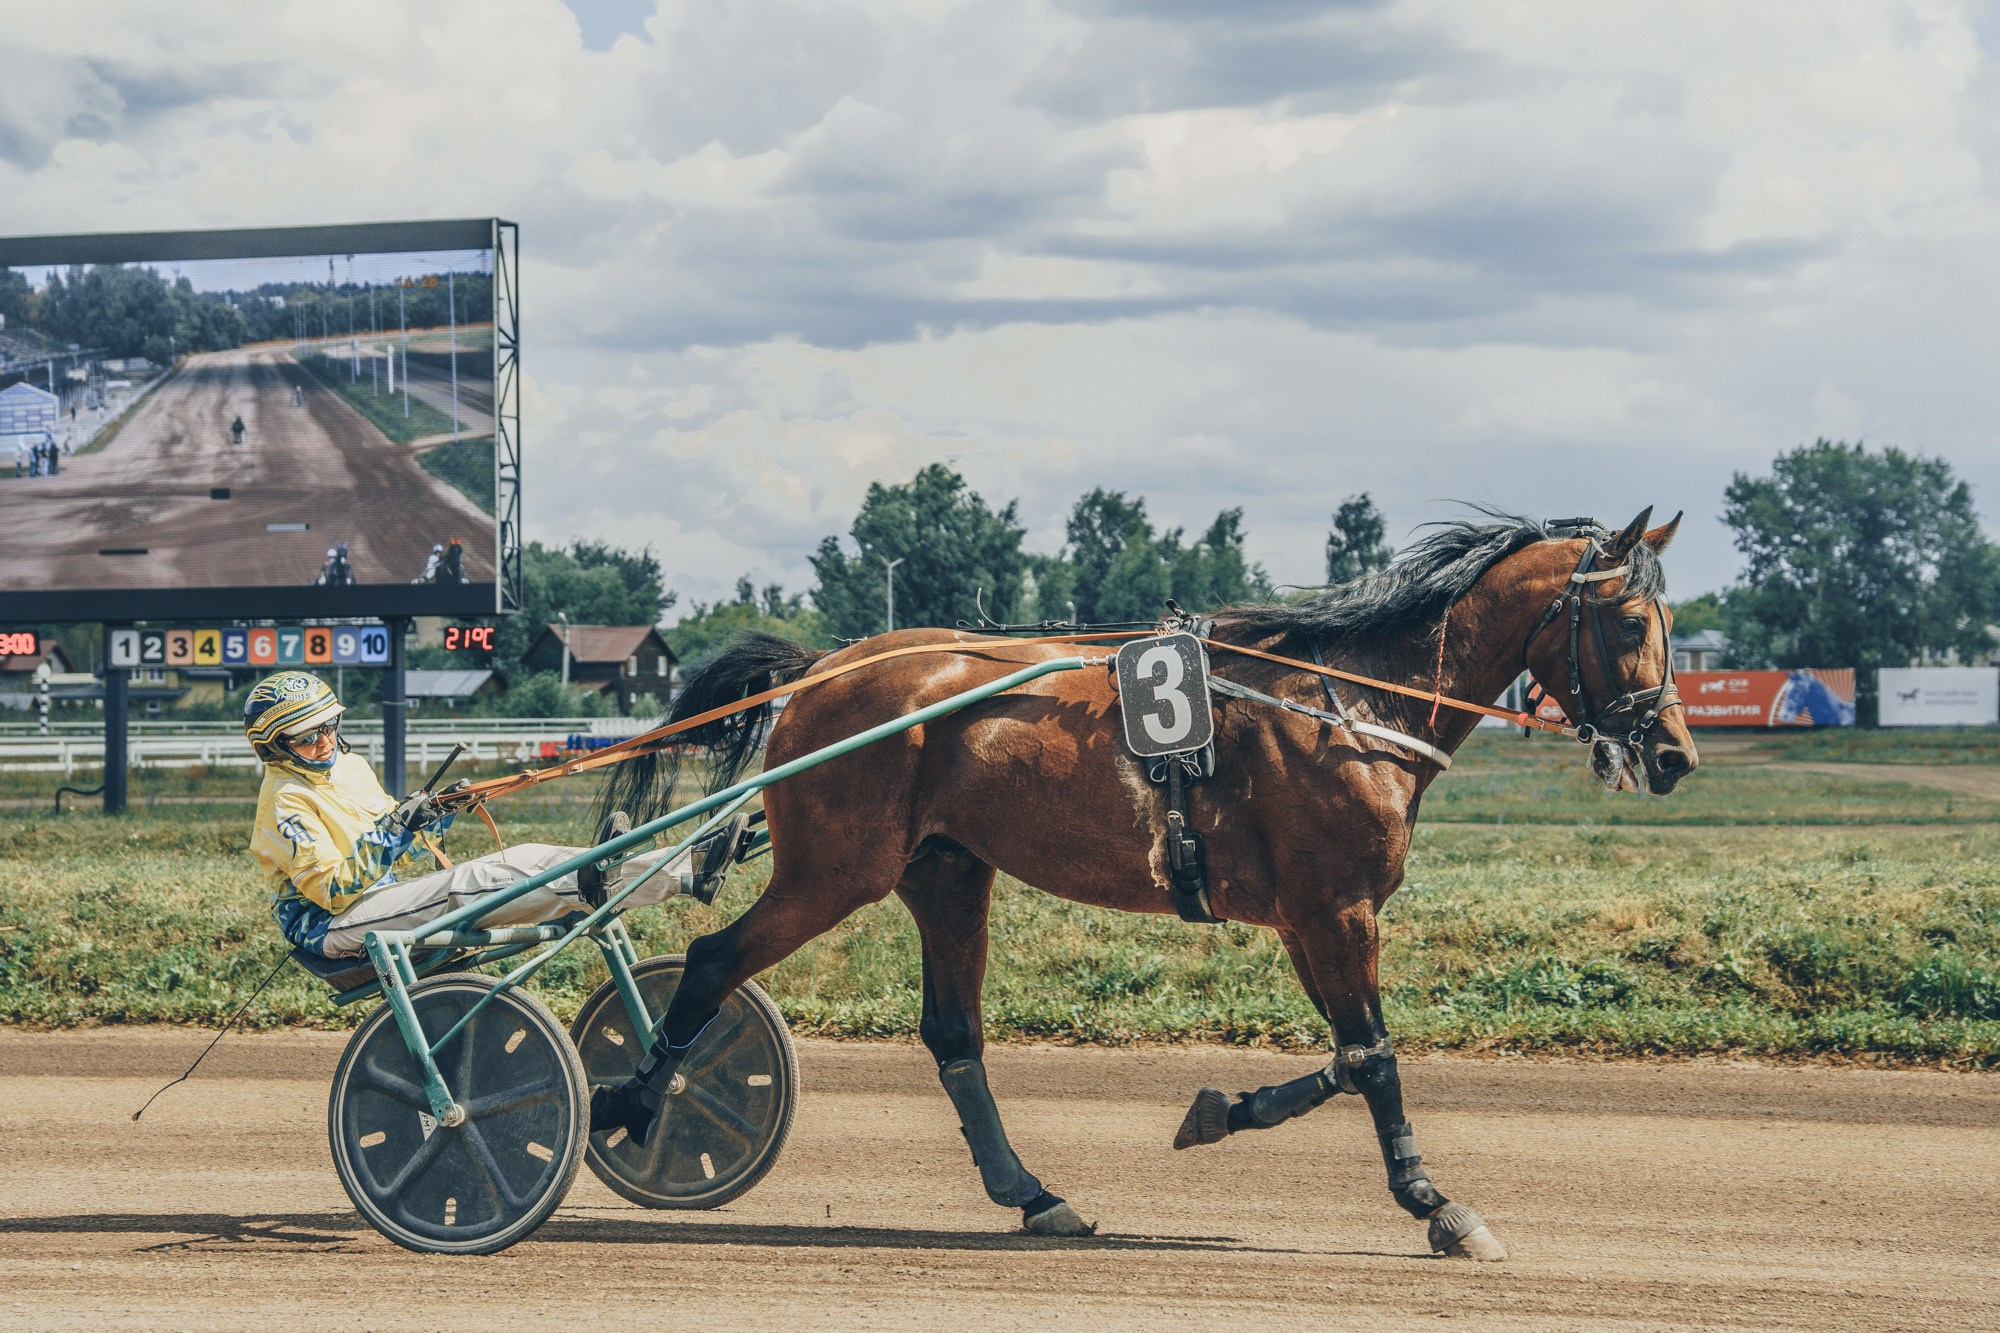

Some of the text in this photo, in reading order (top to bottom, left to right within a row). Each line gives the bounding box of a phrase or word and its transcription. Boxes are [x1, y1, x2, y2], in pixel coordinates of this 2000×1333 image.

[119, 633, 386, 660] 1 2 3 4 5 6 7 8 9 10
[1136, 644, 1192, 744] 3
[1687, 704, 1761, 717] РАЗВИТИЯ
